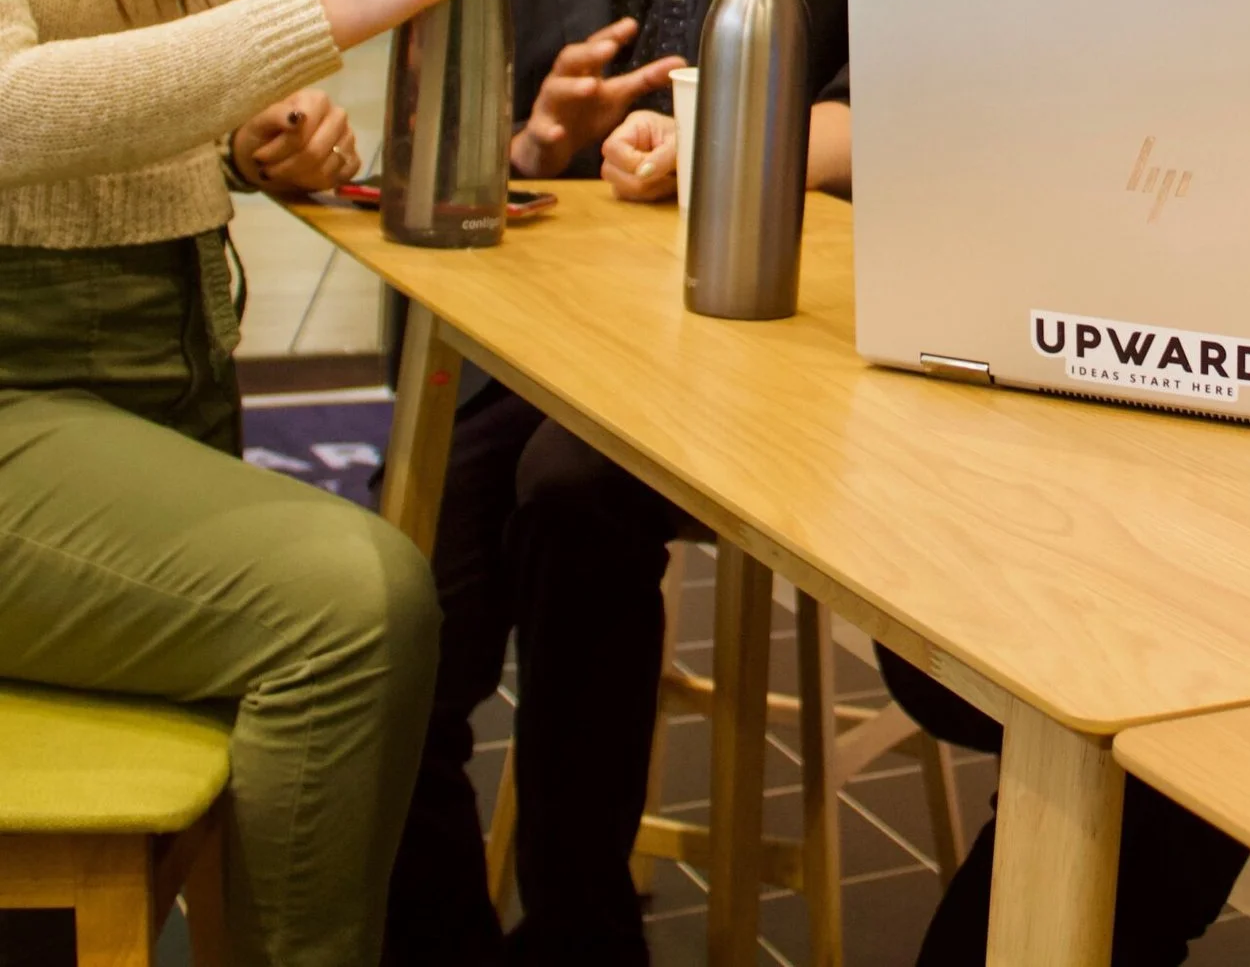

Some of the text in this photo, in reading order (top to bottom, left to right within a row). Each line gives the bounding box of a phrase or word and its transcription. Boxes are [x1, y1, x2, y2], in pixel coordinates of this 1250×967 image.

[1071, 365, 1234, 397] IDEAS START HERE
